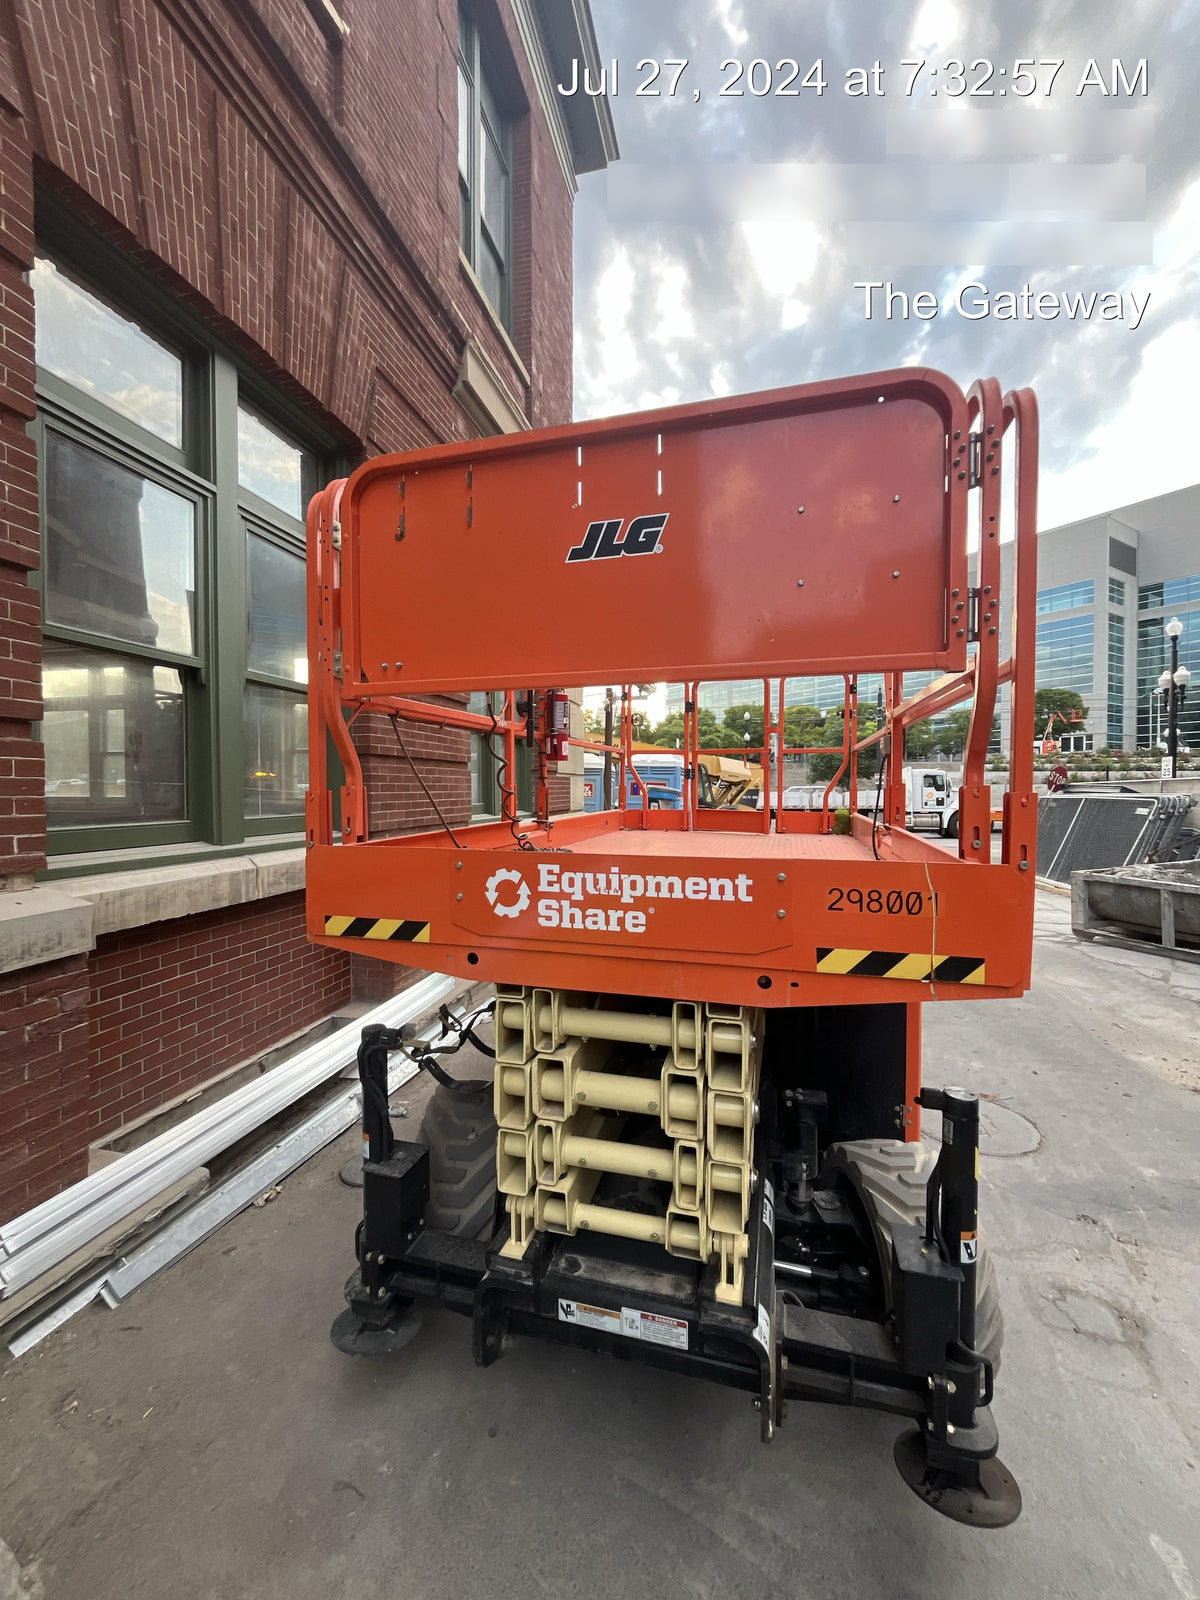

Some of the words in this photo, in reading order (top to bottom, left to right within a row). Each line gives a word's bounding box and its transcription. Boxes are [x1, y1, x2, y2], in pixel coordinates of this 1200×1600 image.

[565, 513, 670, 563] JLG
[1049, 771, 1066, 785] STOP
[537, 863, 753, 903] Equipment
[537, 898, 647, 934] Share
